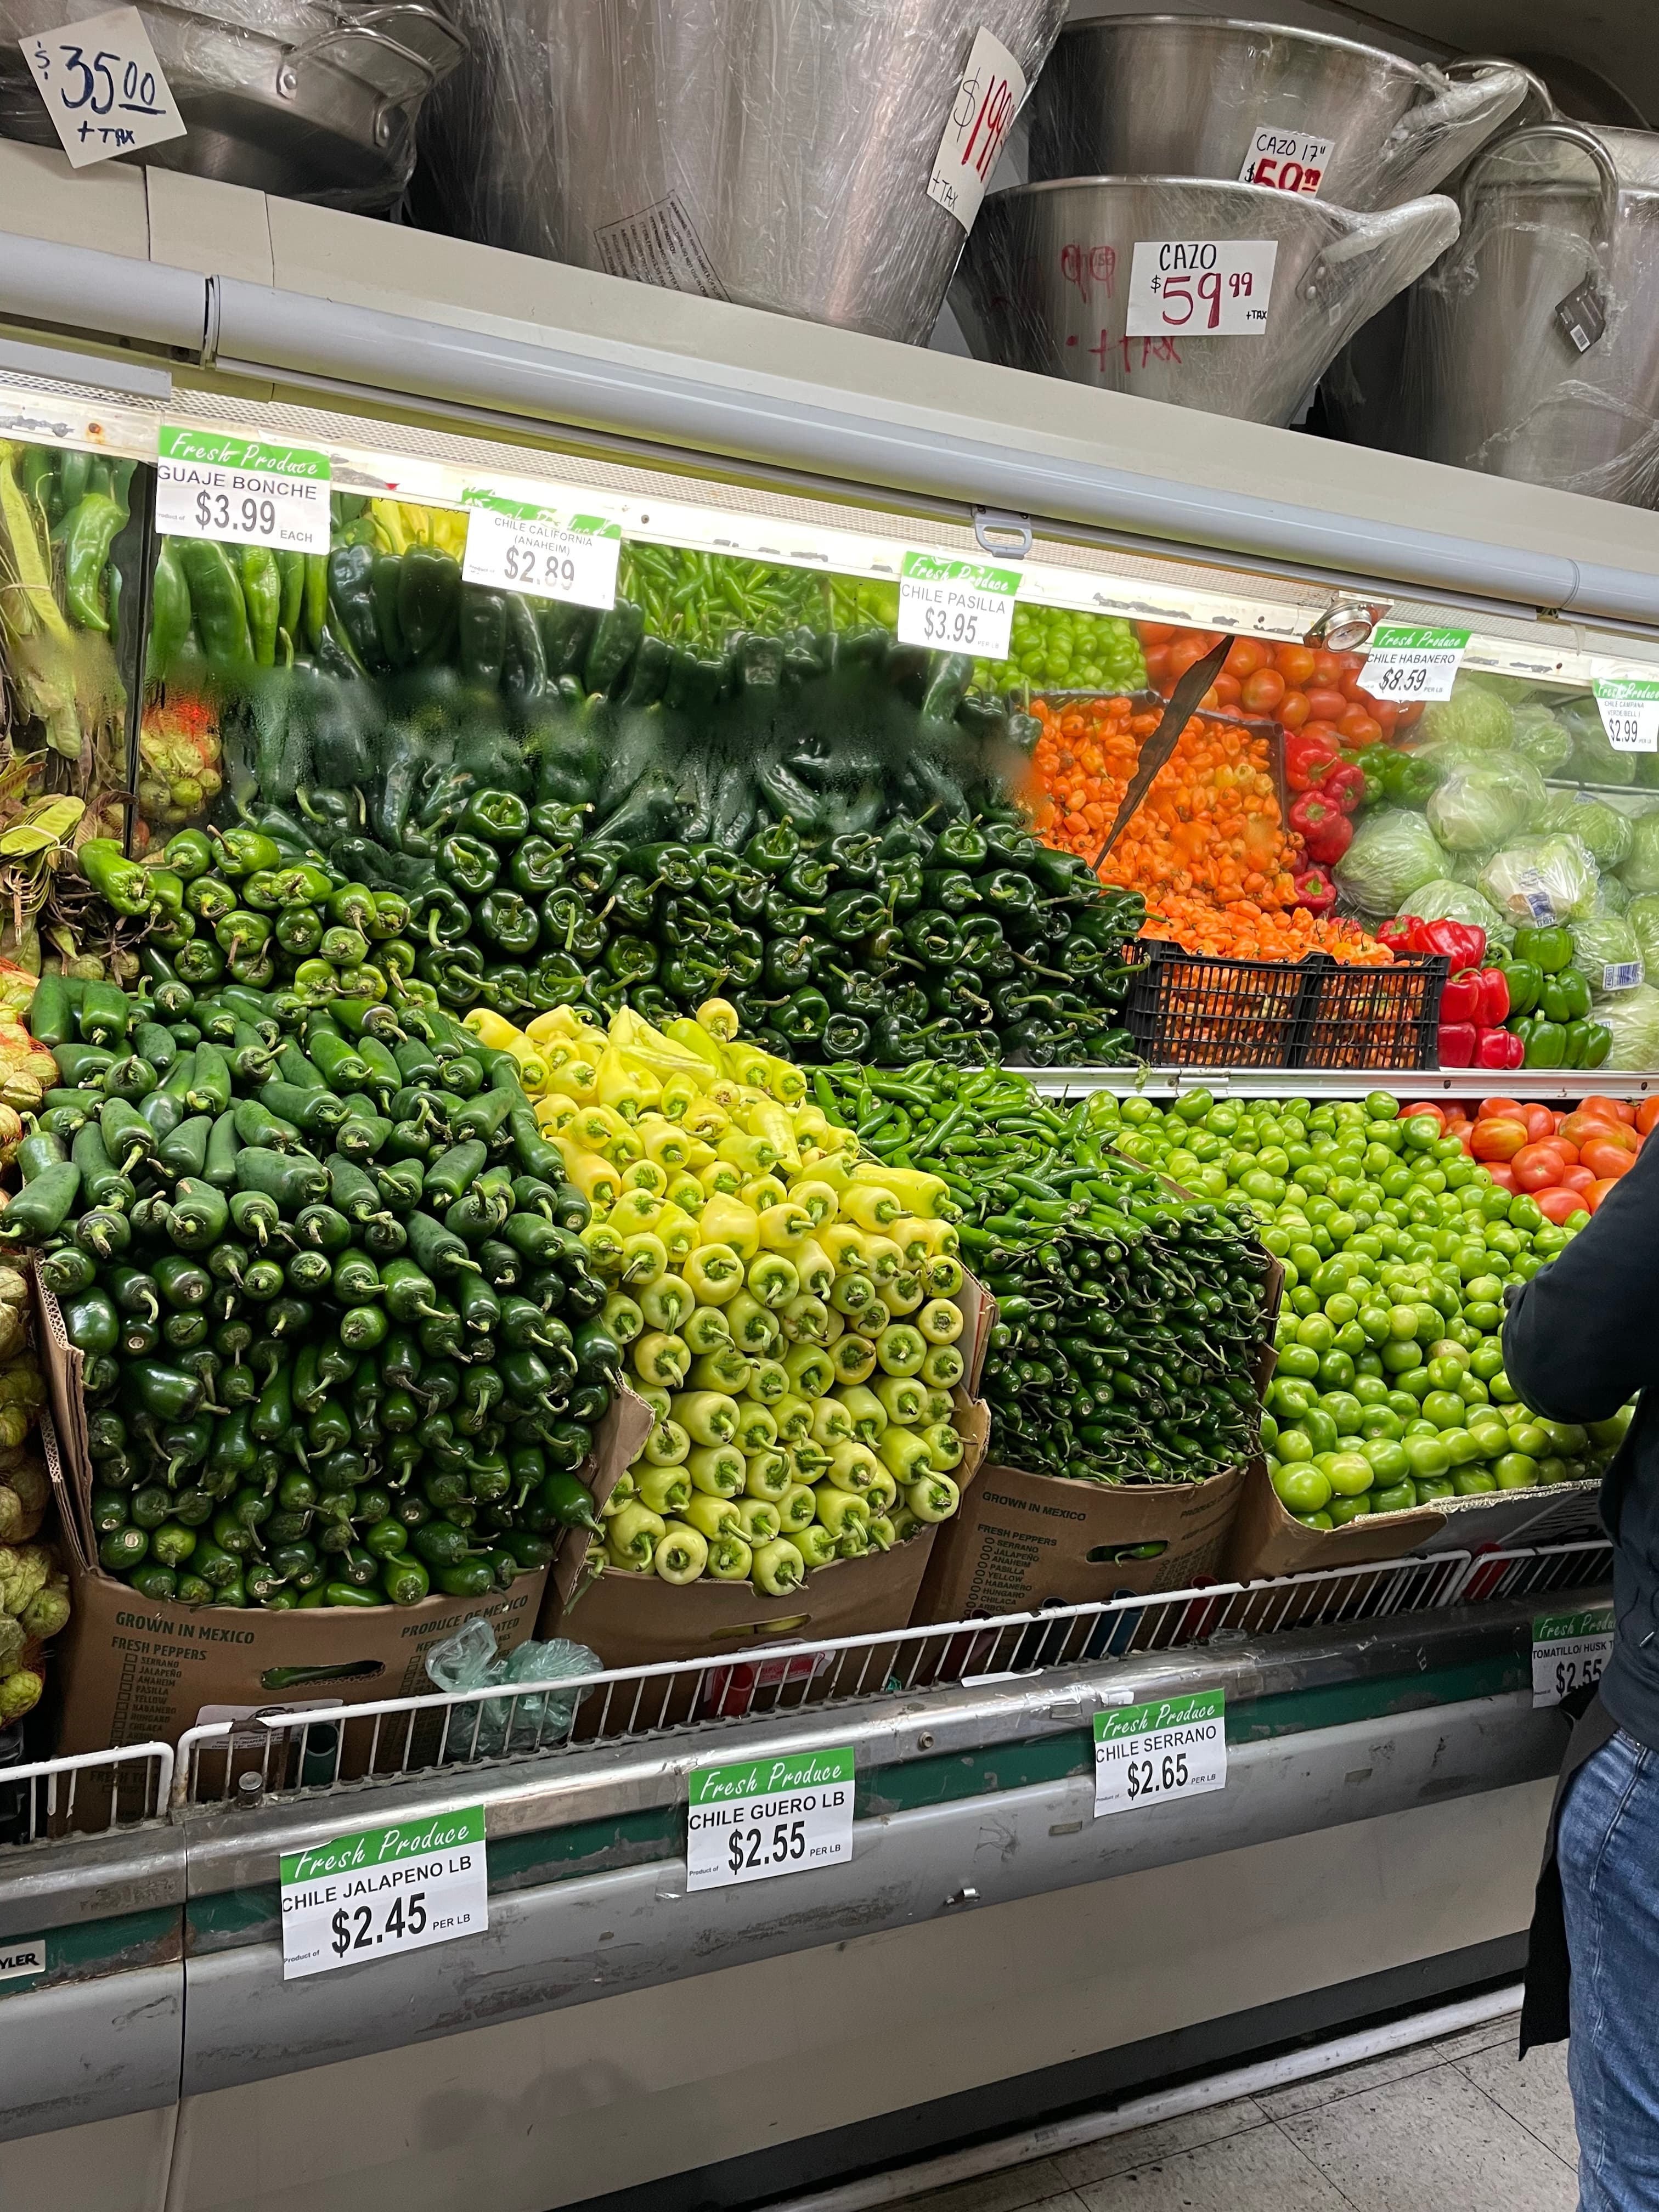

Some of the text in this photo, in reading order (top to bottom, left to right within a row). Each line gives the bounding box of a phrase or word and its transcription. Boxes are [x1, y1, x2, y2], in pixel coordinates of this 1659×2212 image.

[1256, 134, 1296, 156] CAZO
[1159, 244, 1217, 271] CAZO
[170, 432, 318, 475] Fresh Produce
[159, 465, 318, 500] GUAJE BONCHE
[157, 512, 178, 521] roduct
[195, 489, 275, 535] $3.99
[280, 530, 313, 543] EACH
[494, 517, 592, 546] CHILE CALIFORNIA
[514, 534, 571, 556] (ANAHEIM)
[504, 544, 575, 591] $2.89
[909, 556, 1009, 592] Fresh Produce
[901, 584, 1006, 614] CHILE PASILLA
[924, 606, 978, 644] $3.95
[1378, 629, 1462, 647] Fresh Produce
[1367, 653, 1455, 664] CHILE HABANERO
[1379, 667, 1427, 693] $8.59
[1609, 718, 1638, 744] $2.99
[982, 1491, 1086, 1521] GROWN IN MEXICO
[977, 1523, 1058, 1547] FRESH PEPPERS
[996, 1539, 1039, 1553] SERRANO
[991, 1556, 1031, 1568] ANAHEIM
[994, 1548, 1040, 1562] JALAPEÑO
[988, 1571, 1024, 1583] YELLOW
[989, 1564, 1025, 1576] PASILLA
[983, 1587, 1025, 1599] HUNGARO
[985, 1579, 1032, 1592] HABANERO
[980, 1595, 1017, 1605] CHILACA
[116, 1611, 255, 1644] GROWN IN MEXICO
[400, 1615, 462, 1638] PRODUCE
[1539, 1617, 1576, 1638] Fresh
[111, 1636, 207, 1661] FRESH PEPPERS
[1584, 1641, 1606, 1653] HUSK
[139, 1666, 182, 1678] JALAPEÑO
[140, 1657, 179, 1668] SERRANO
[135, 1685, 169, 1696] PASILLA
[137, 1676, 176, 1688] ANAHEIM
[133, 1694, 167, 1705] YELLOW
[1102, 1700, 1215, 1739] Fresh Produce
[1097, 1725, 1216, 1763] CHILE SERRANO
[700, 1758, 842, 1801] Fresh Produce
[1127, 1753, 1188, 1801] $2.65
[1206, 1774, 1216, 1782] LB
[689, 1791, 845, 1830] CHILE GUERO LB
[294, 1821, 470, 1879] Fresh Produce
[728, 1820, 805, 1875] $2.55
[810, 1844, 841, 1858] PER LB
[689, 1867, 712, 1877] Product
[283, 1855, 472, 1913] CHILE JALAPENO LB
[331, 1892, 427, 1958] $2.45
[432, 1914, 471, 1931] PER LB
[284, 1949, 320, 1965] Product of
